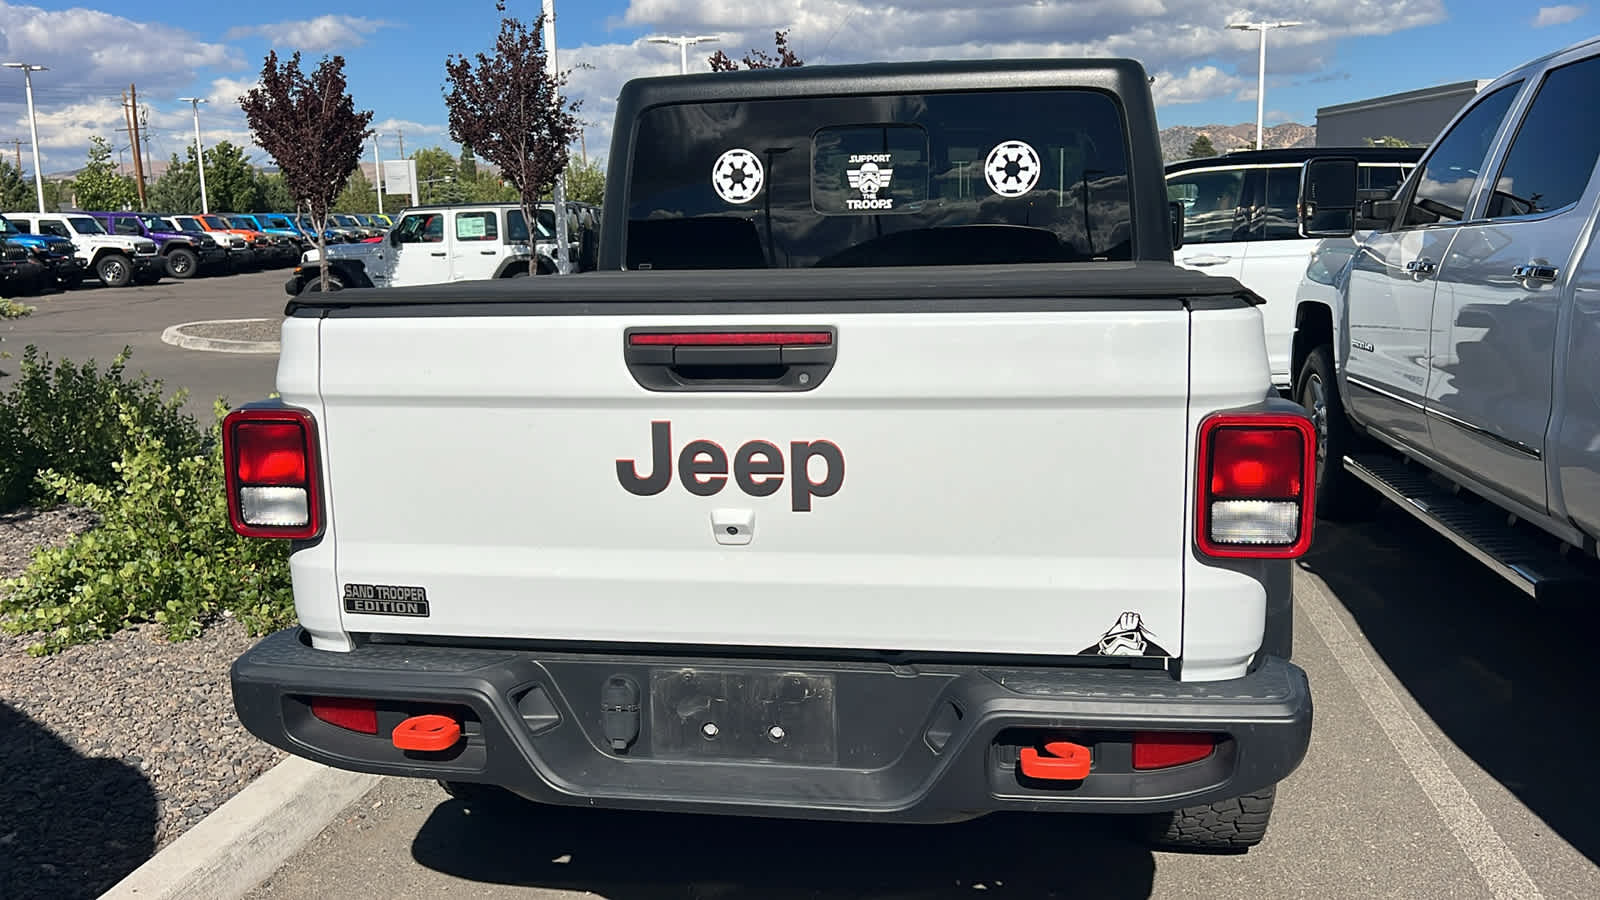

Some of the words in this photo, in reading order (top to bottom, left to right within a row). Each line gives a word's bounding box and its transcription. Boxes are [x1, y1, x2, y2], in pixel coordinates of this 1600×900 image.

[848, 154, 891, 163] SUPPORT
[846, 199, 893, 209] TROOPS
[616, 420, 845, 512] Jeep
[345, 585, 375, 599] SAND
[376, 587, 425, 602] TROOPER
[354, 600, 418, 613] EDITION
